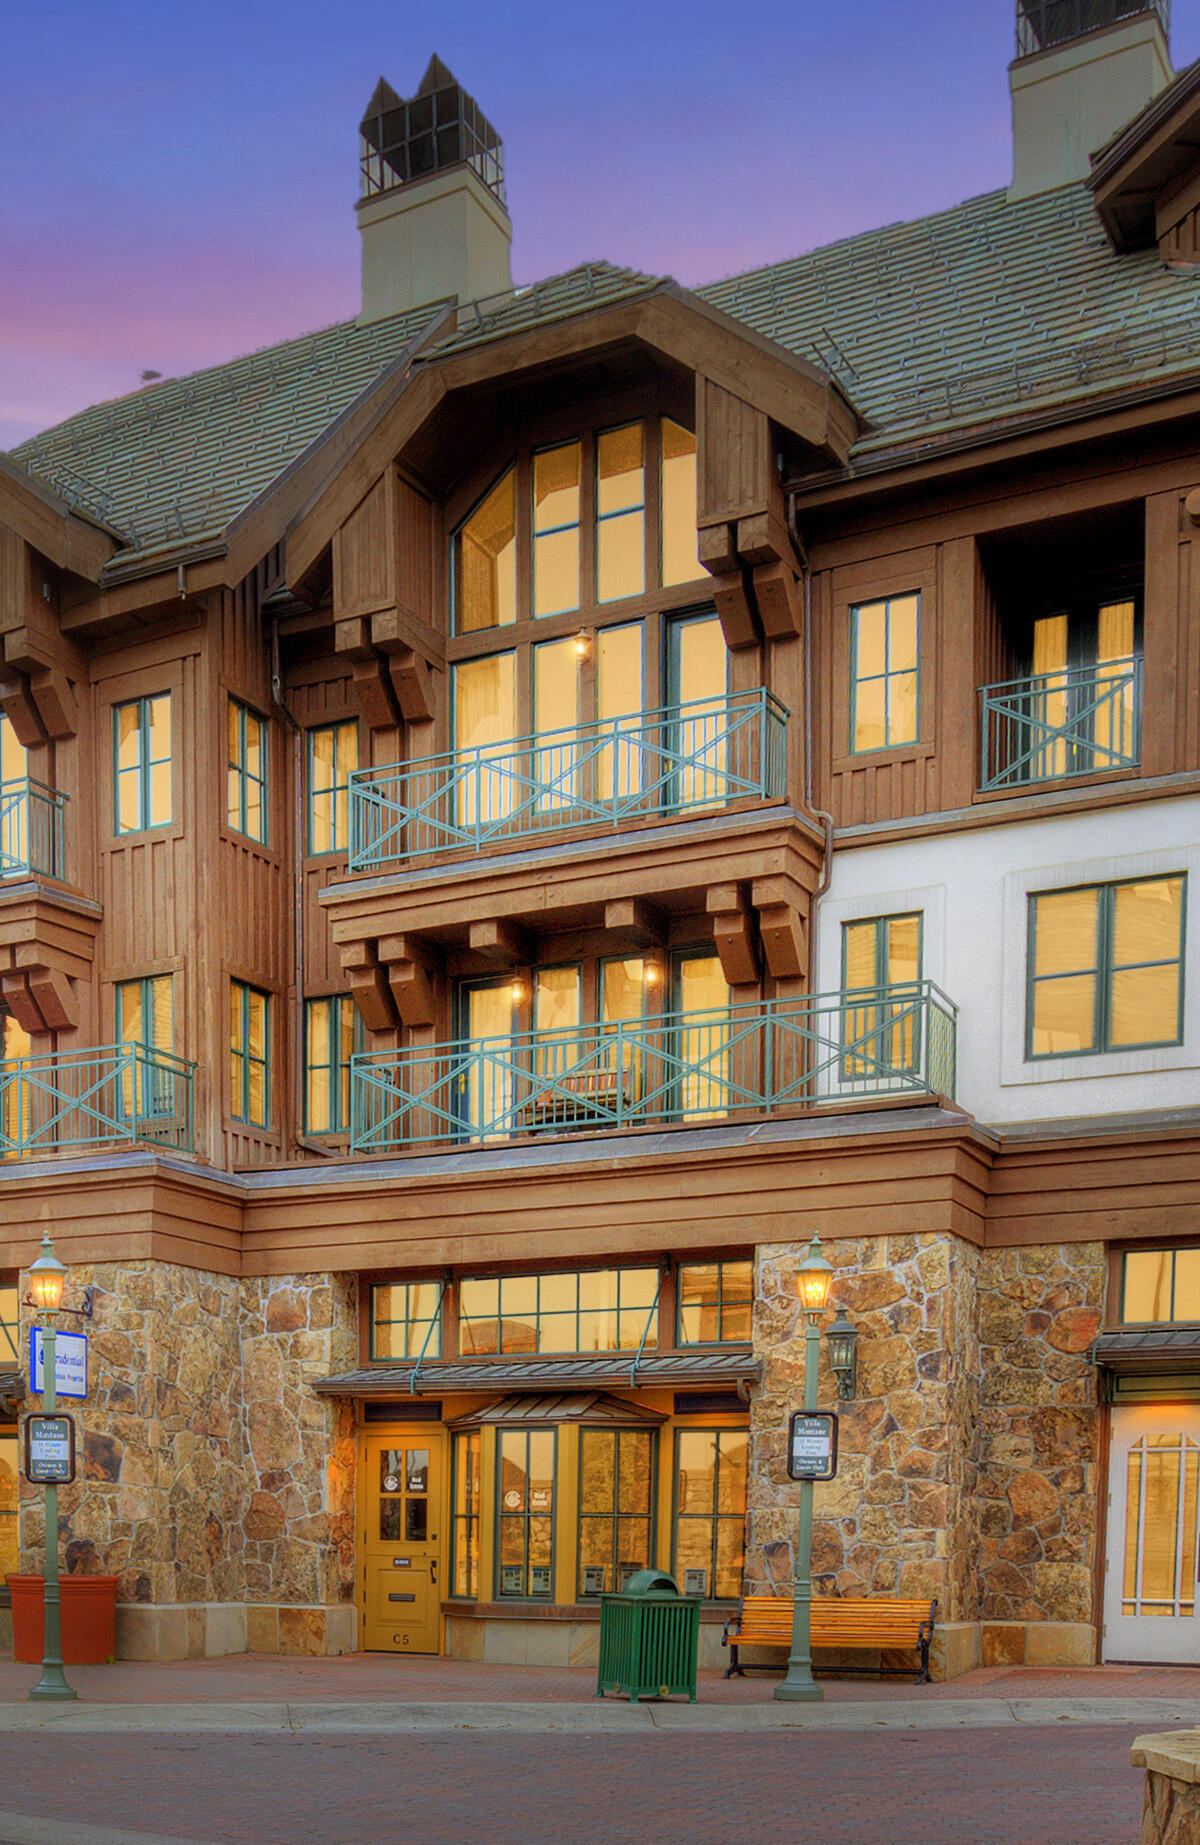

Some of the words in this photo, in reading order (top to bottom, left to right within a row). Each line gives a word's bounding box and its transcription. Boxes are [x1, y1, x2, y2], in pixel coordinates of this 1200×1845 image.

[55, 1353, 84, 1366] rudential
[41, 1422, 58, 1430] Villa
[804, 1418, 821, 1427] Villa
[392, 1633, 409, 1645] C5
